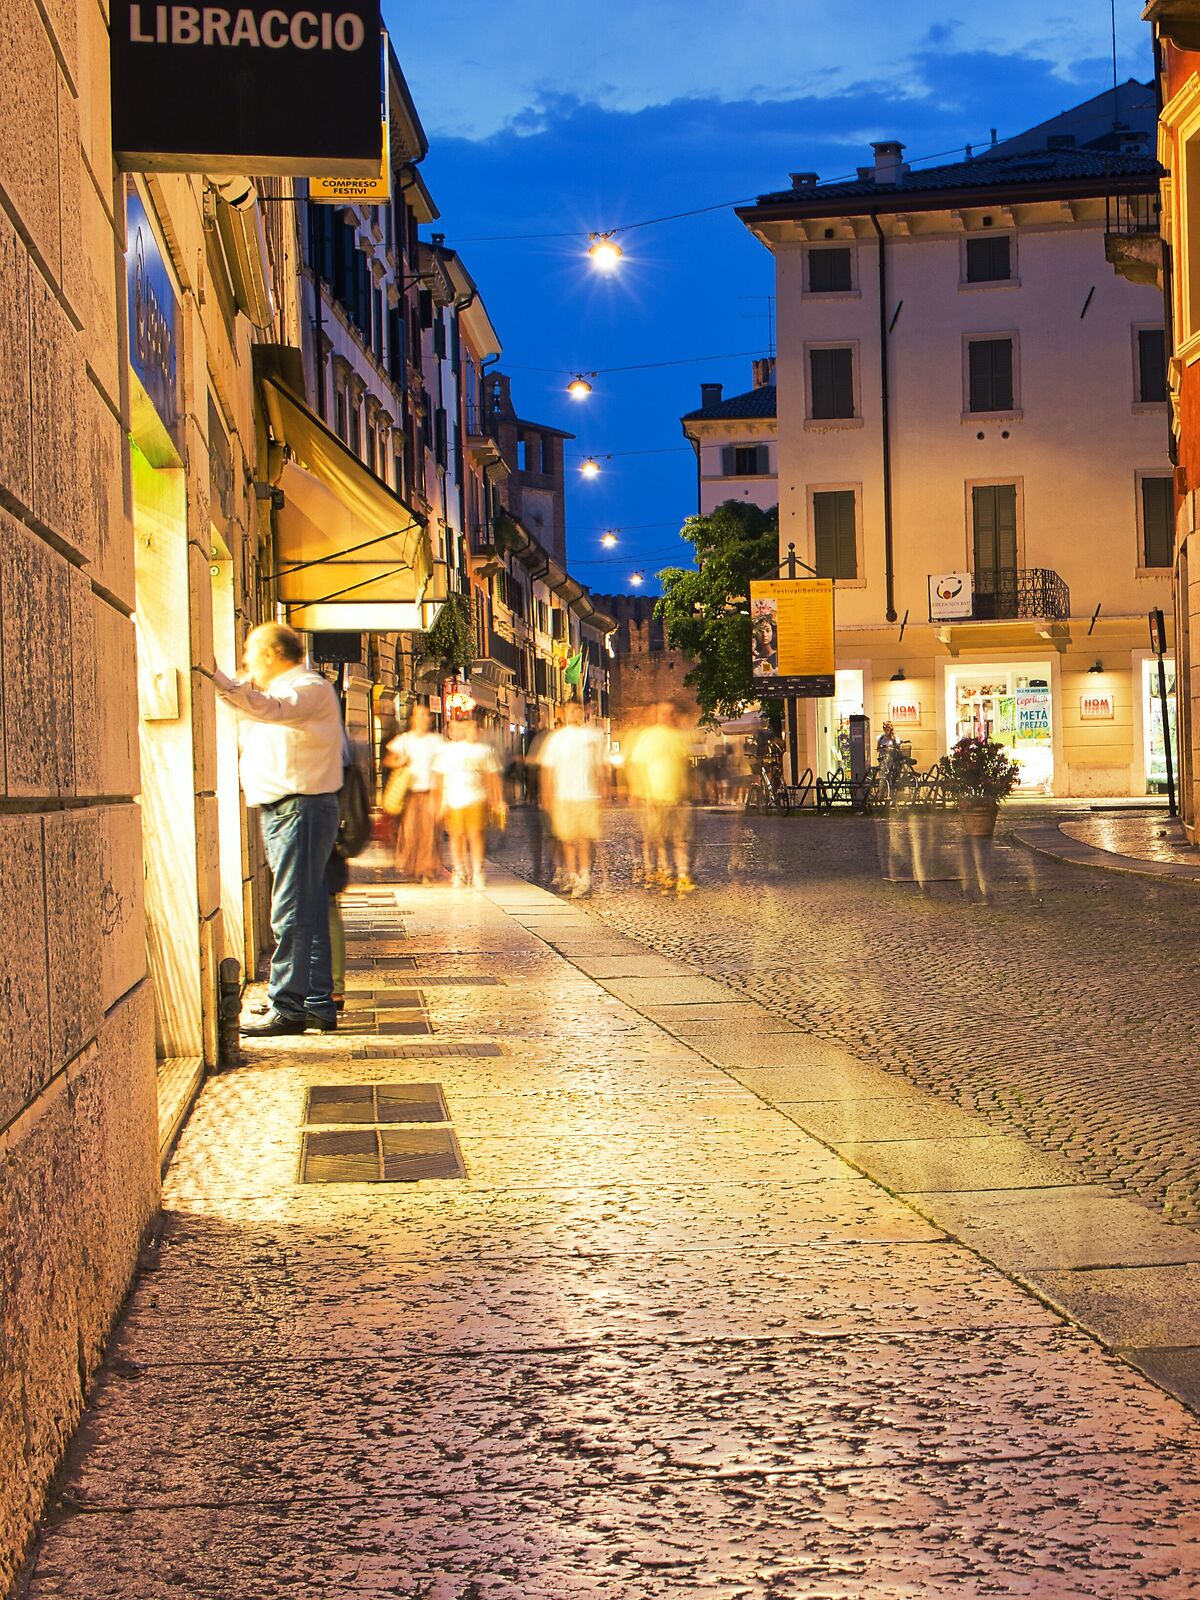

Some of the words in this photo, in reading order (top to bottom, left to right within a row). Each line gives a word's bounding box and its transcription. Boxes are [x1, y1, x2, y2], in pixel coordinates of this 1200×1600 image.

[130, 4, 365, 51] LIBRACCIO
[322, 180, 377, 188] COMPRESO
[1020, 707, 1048, 720] METÀ
[1020, 721, 1049, 729] PREZZO
